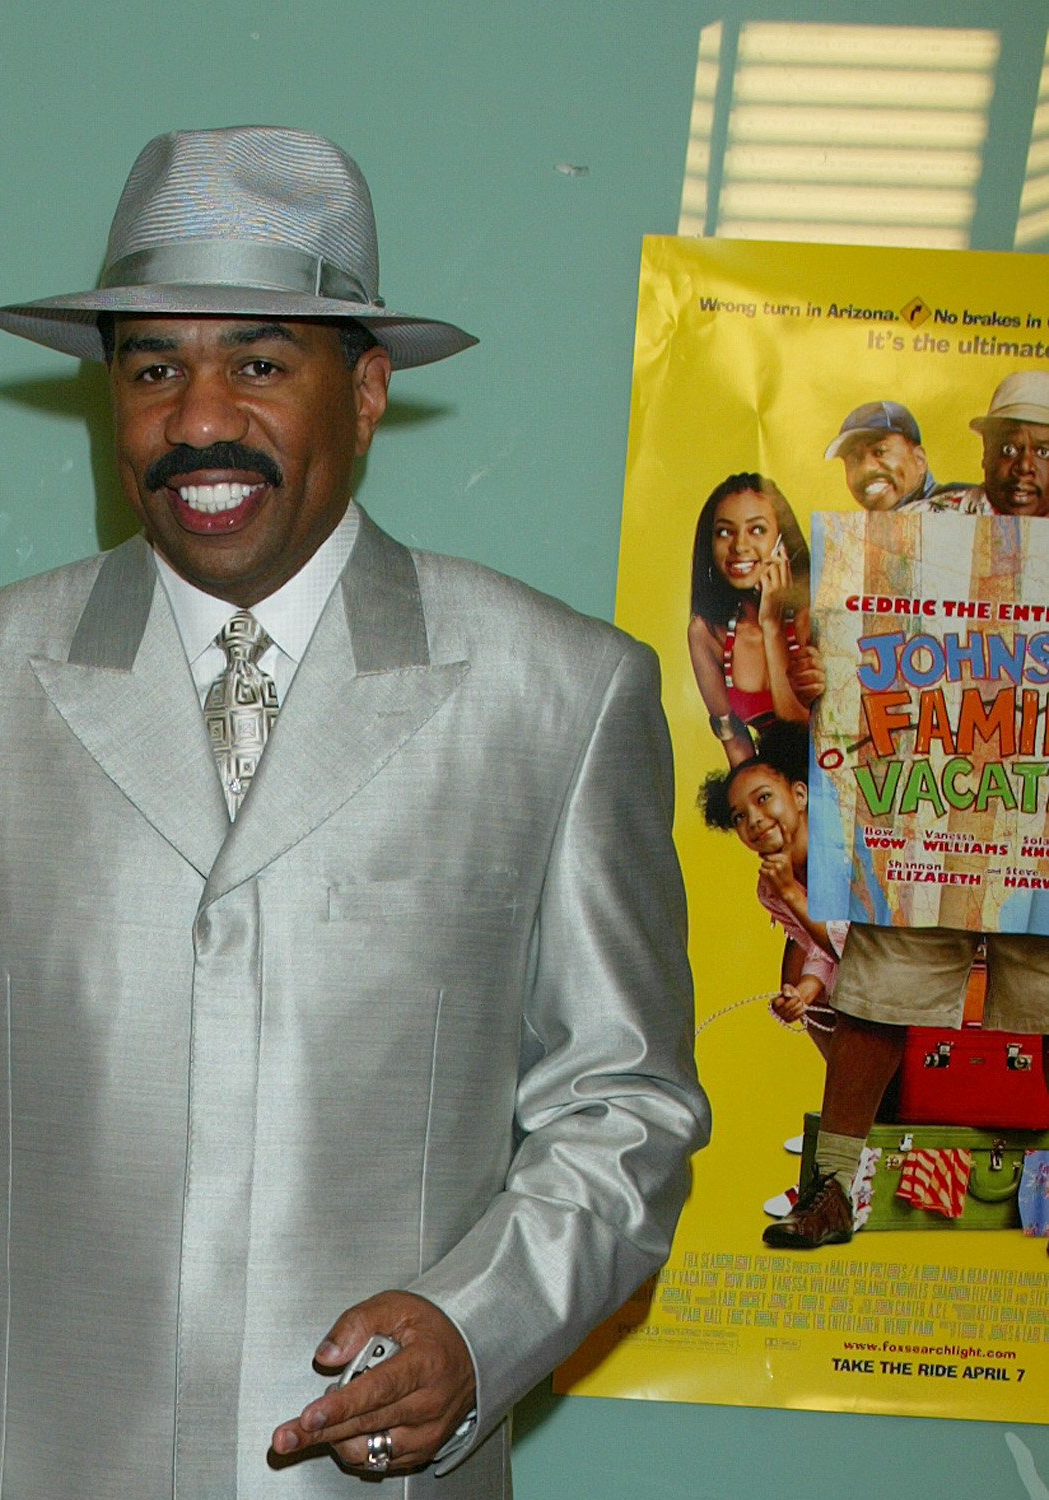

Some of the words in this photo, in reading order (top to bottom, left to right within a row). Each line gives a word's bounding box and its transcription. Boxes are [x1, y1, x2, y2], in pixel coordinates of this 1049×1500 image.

[699, 297, 757, 318] Wrong
[763, 300, 800, 317] turn
[806, 301, 822, 318] in
[826, 303, 899, 322] Arizona.
[933, 308, 958, 325] No
[962, 309, 1021, 328] brakes
[1026, 312, 1042, 329] in
[867, 330, 905, 351] It's
[912, 333, 950, 353] the
[845, 595, 936, 616] CEDRIC
[942, 600, 991, 619] THE
[865, 837, 906, 849] WOW
[925, 829, 975, 842] Vanessa
[923, 840, 1008, 856] WILLIAMS
[888, 859, 942, 871] Shannon
[1006, 866, 1039, 877] Steve
[887, 869, 981, 885] ELIZABETH
[844, 1340, 1016, 1360] www.foxsearchlight.com
[832, 1357, 874, 1373] TAKE
[879, 1360, 913, 1375] THE
[918, 1362, 958, 1378] RIDE
[962, 1365, 1011, 1381] APRIL
[1016, 1368, 1026, 1382] 7
